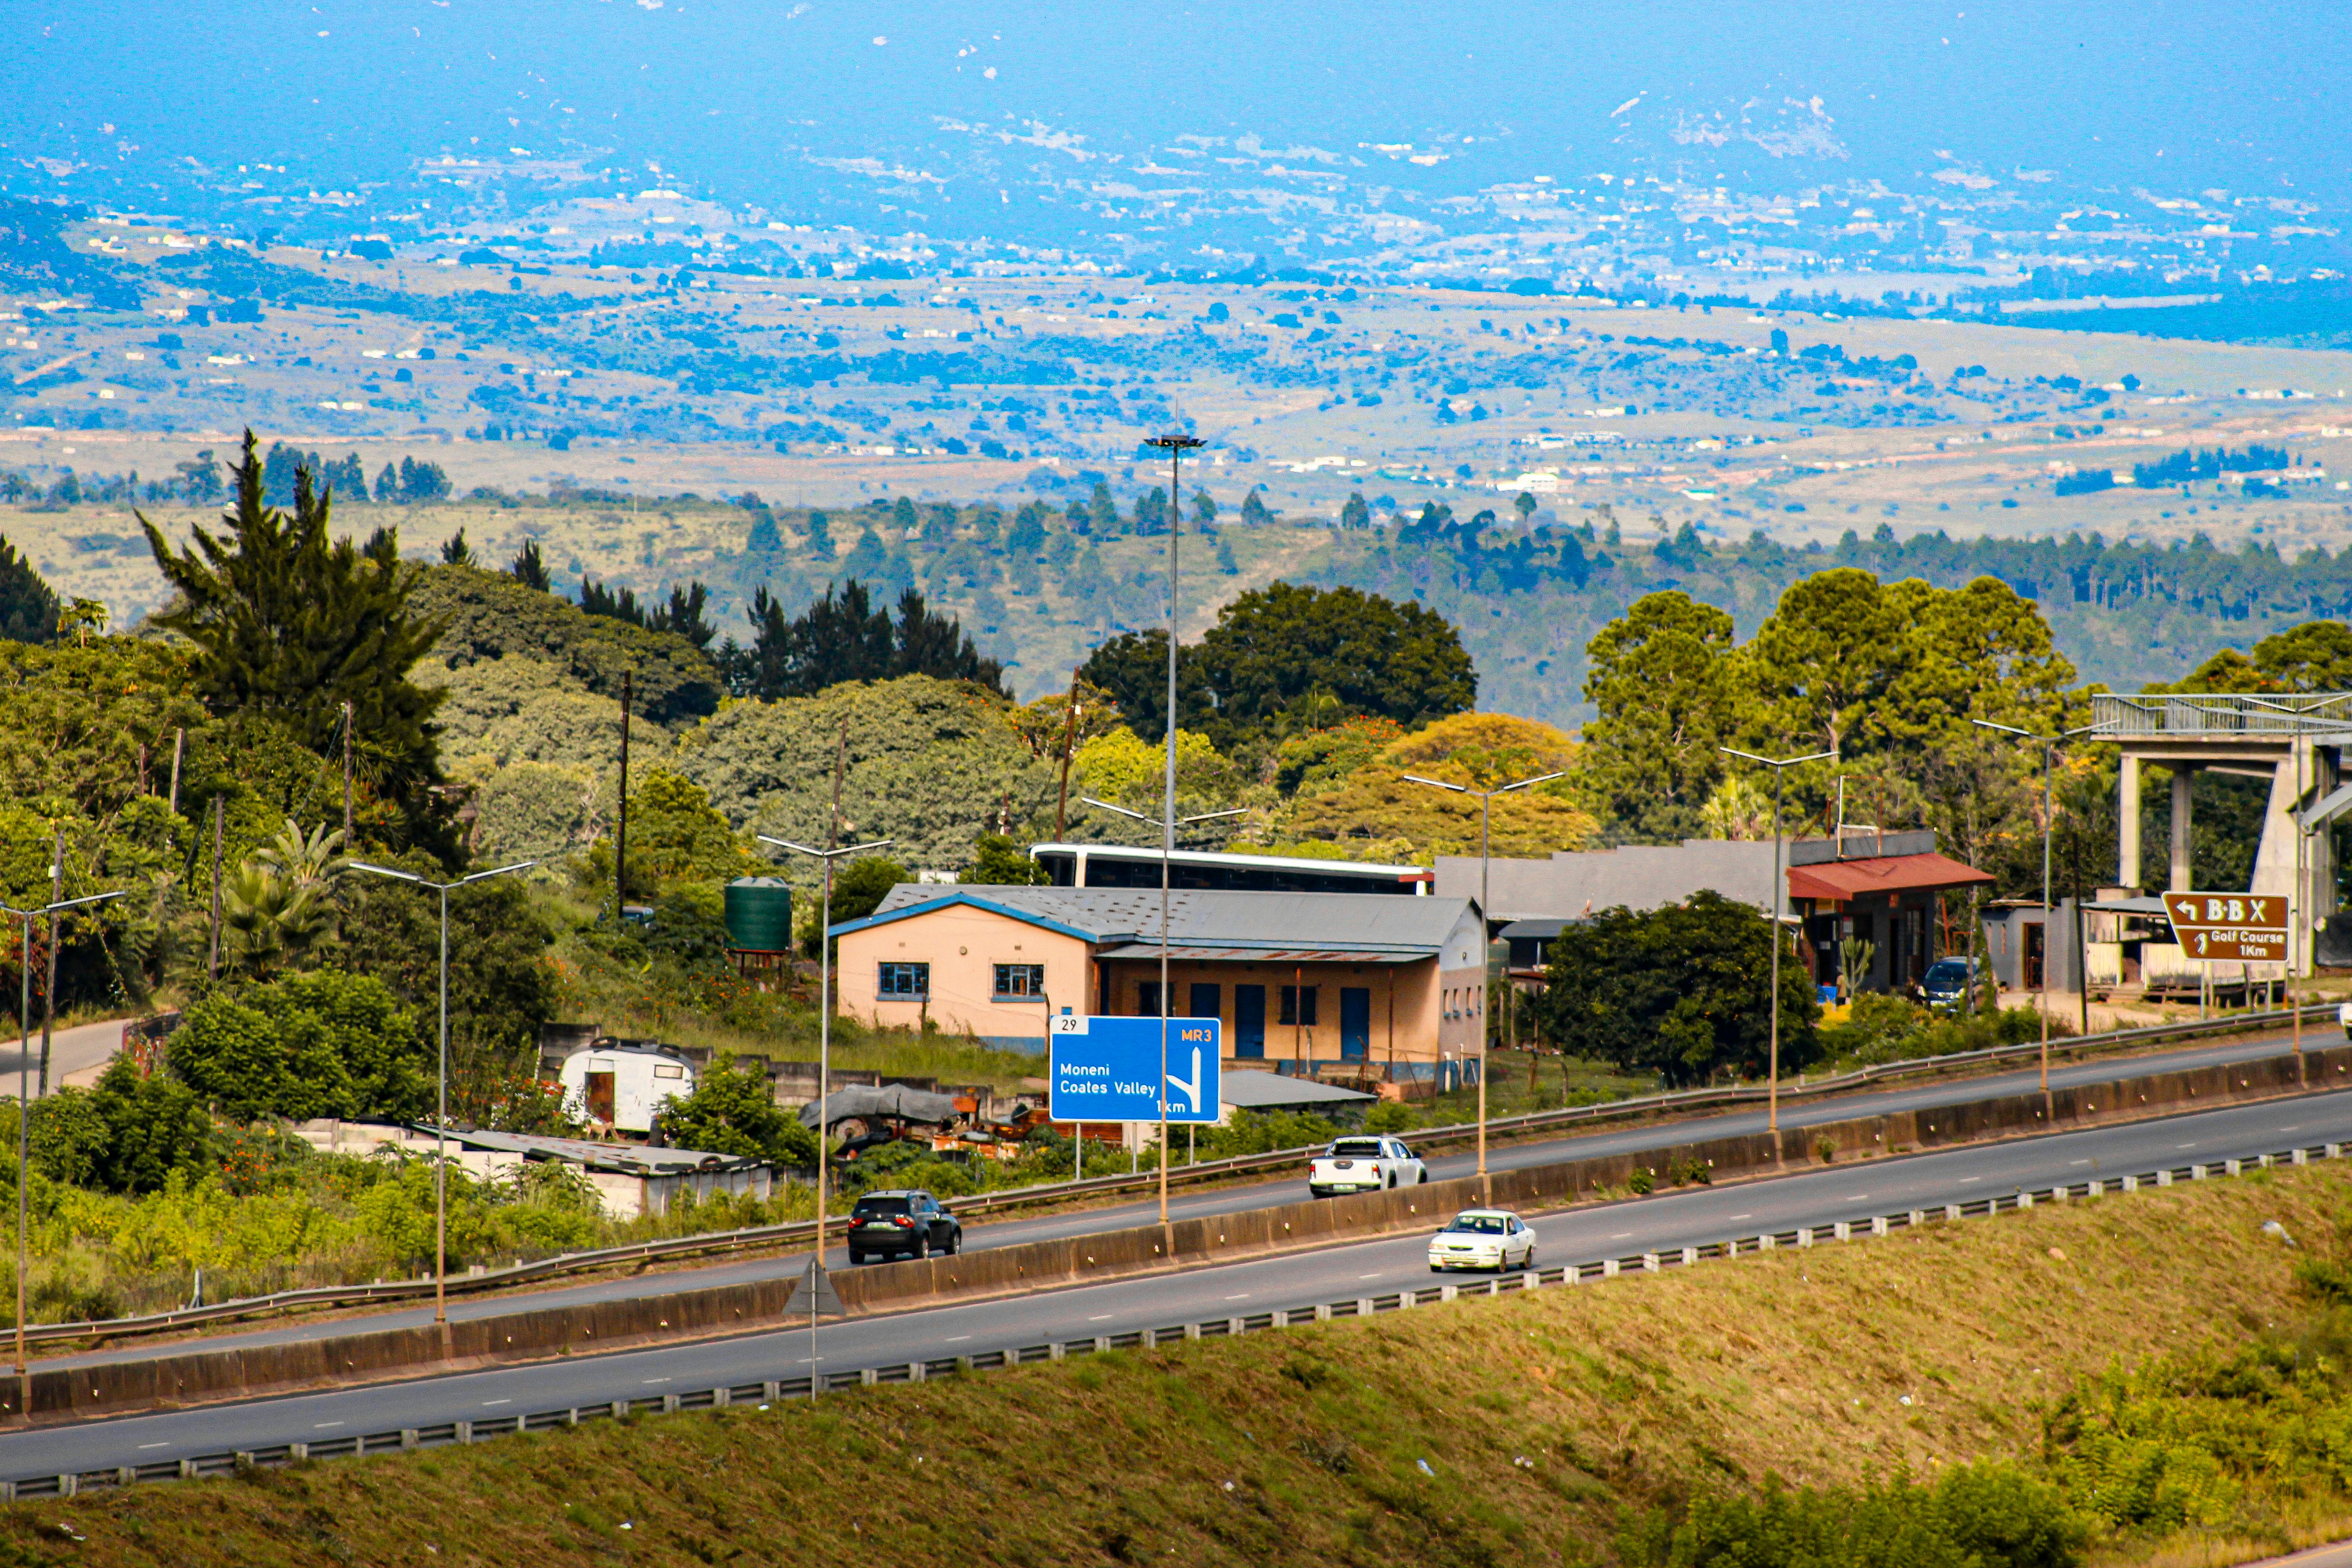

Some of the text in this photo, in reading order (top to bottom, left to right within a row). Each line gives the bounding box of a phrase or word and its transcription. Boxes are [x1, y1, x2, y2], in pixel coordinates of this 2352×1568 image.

[2211, 930, 2284, 944] Golf Course
[1062, 1019, 1076, 1030] 29
[1181, 1029, 1212, 1042] MR3
[1060, 1063, 1109, 1075] Moneni
[1060, 1080, 1156, 1098] Coates Valley
